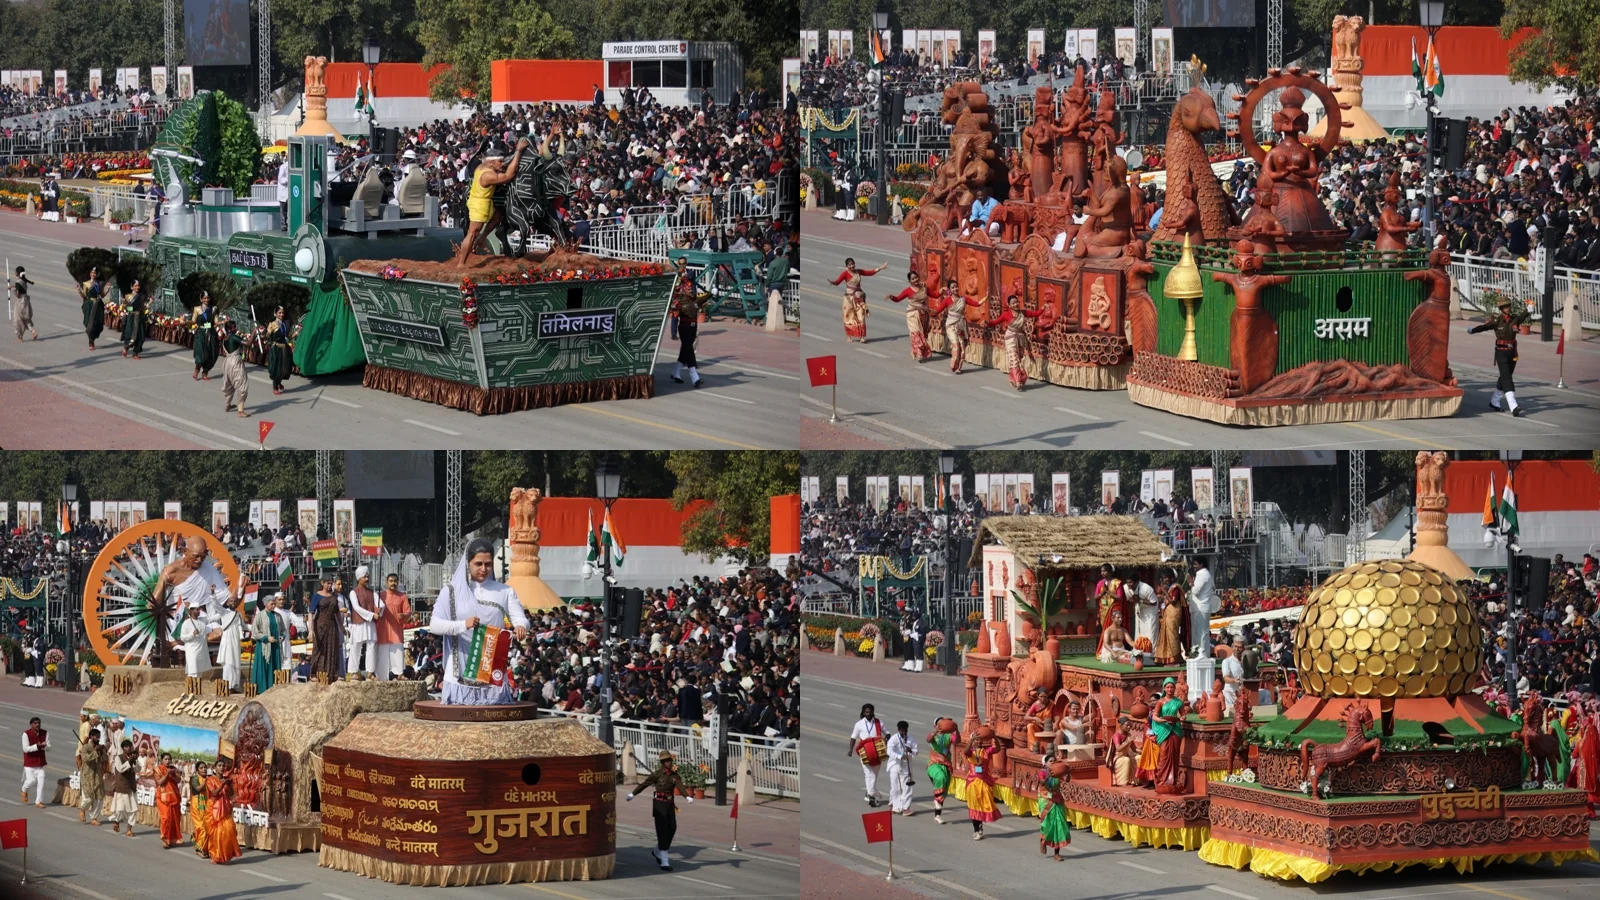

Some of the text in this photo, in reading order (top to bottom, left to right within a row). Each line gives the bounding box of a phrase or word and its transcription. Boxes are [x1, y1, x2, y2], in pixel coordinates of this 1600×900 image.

[613, 44, 679, 54] PARADE CONTROL CENTRE
[1313, 317, 1371, 340] असम
[410, 774, 466, 793] वंदे मातरम्
[466, 804, 591, 855] गुजरात
[401, 840, 440, 859] मातरम्
